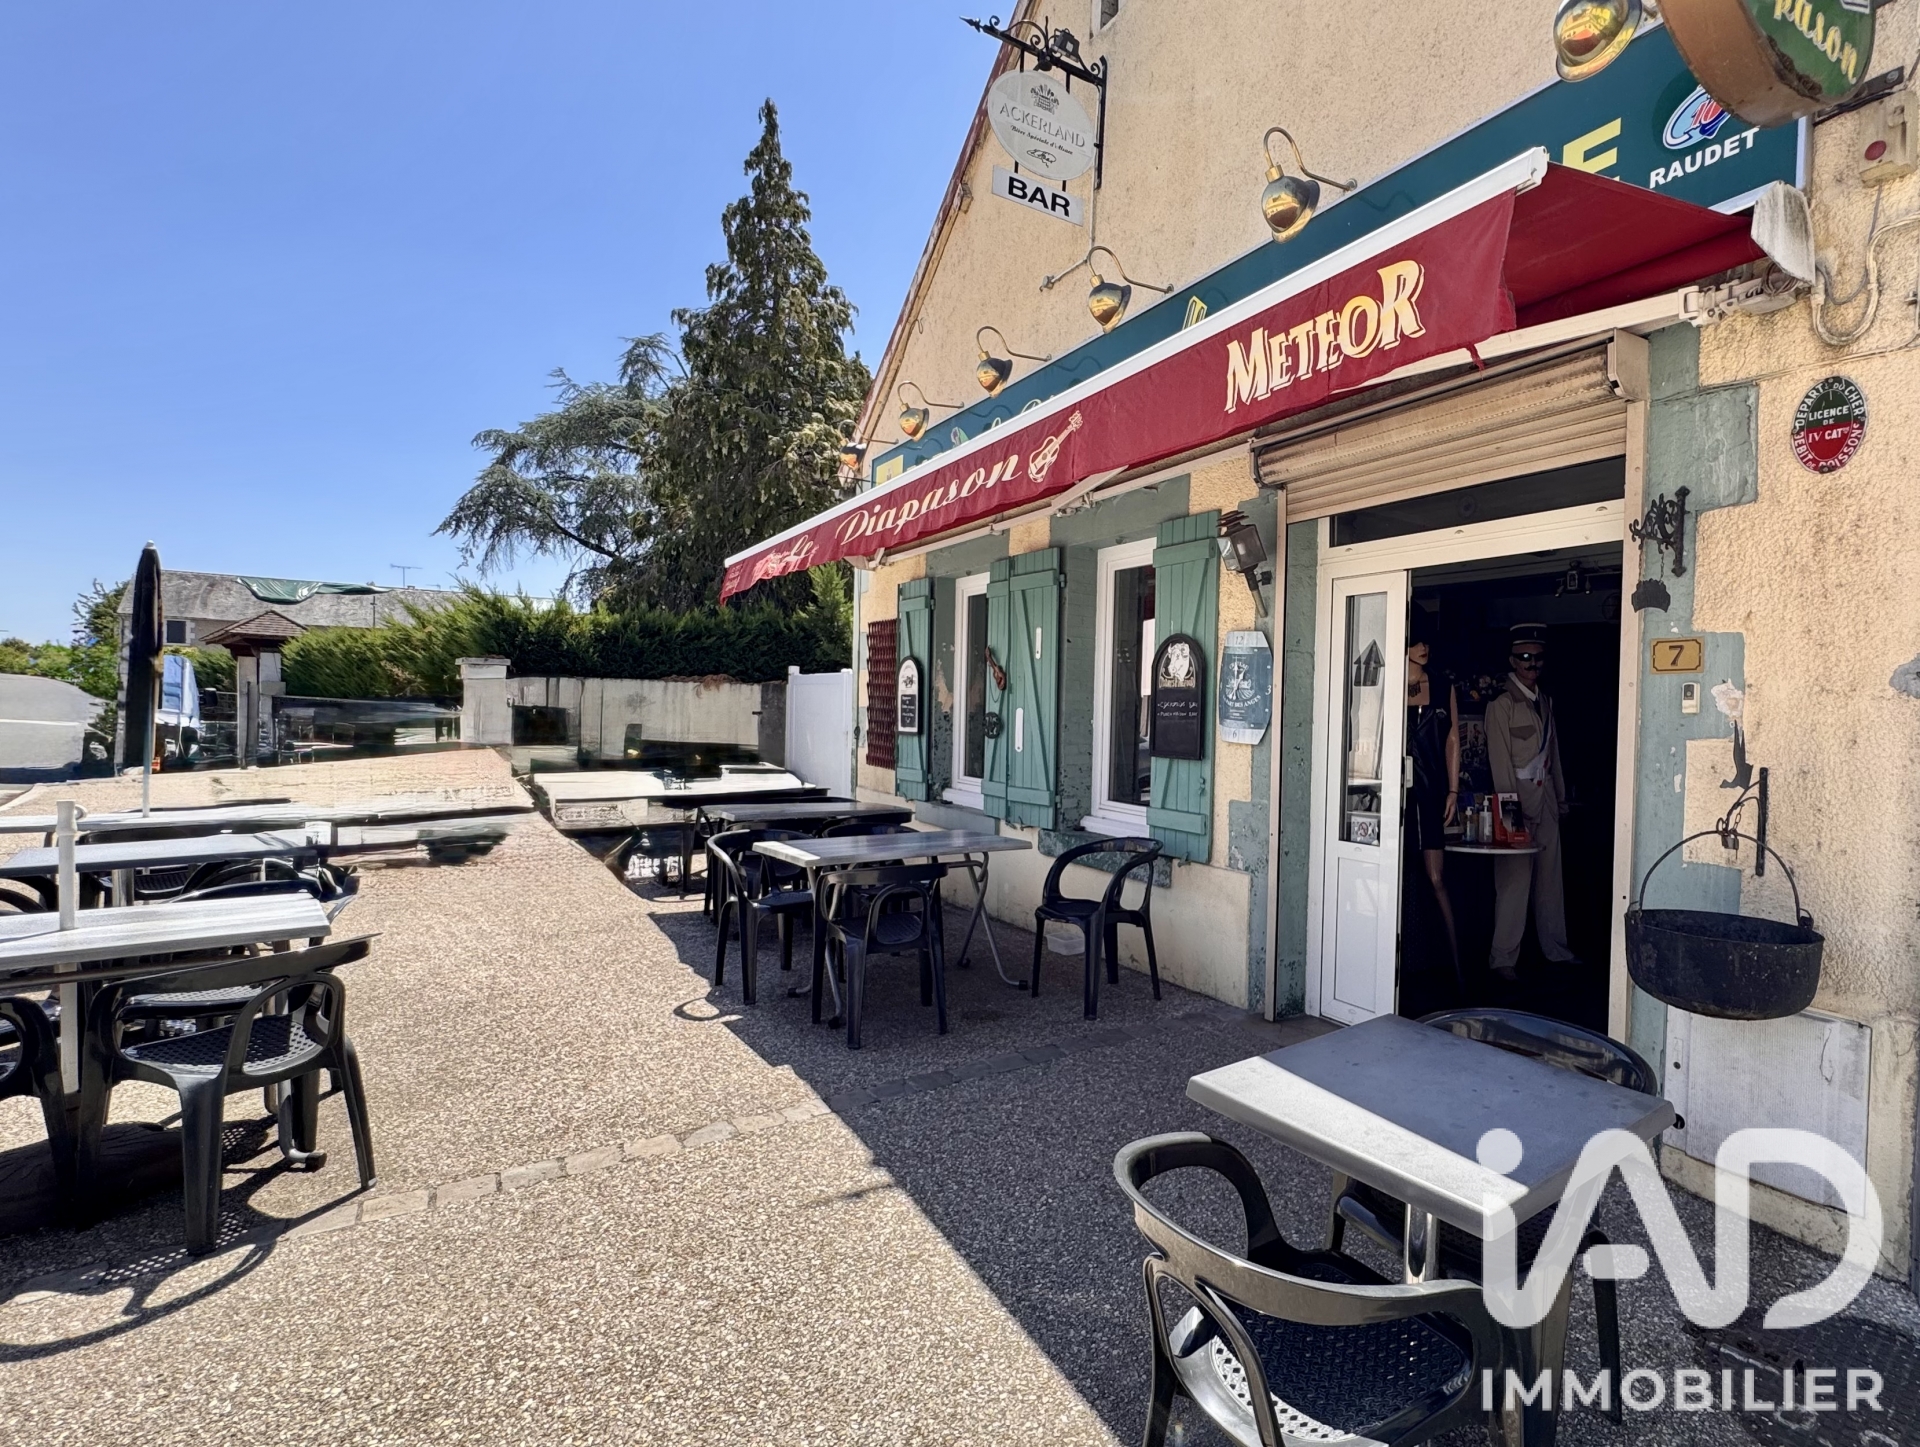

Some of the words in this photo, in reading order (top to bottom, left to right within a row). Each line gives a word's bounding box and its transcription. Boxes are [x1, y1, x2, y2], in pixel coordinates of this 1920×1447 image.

[999, 103, 1085, 147] ACKERLAND
[1649, 125, 1760, 189] RAUDET
[1007, 175, 1071, 218] BAR
[1224, 259, 1426, 414] METEOR
[1808, 405, 1850, 421] LICENCE
[1845, 385, 1864, 416] CHER
[1807, 431, 1823, 443] IV
[1822, 418, 1835, 426] DE
[835, 454, 1023, 546] Diapason
[1669, 645, 1684, 667] 7
[1264, 684, 1272, 696] 3
